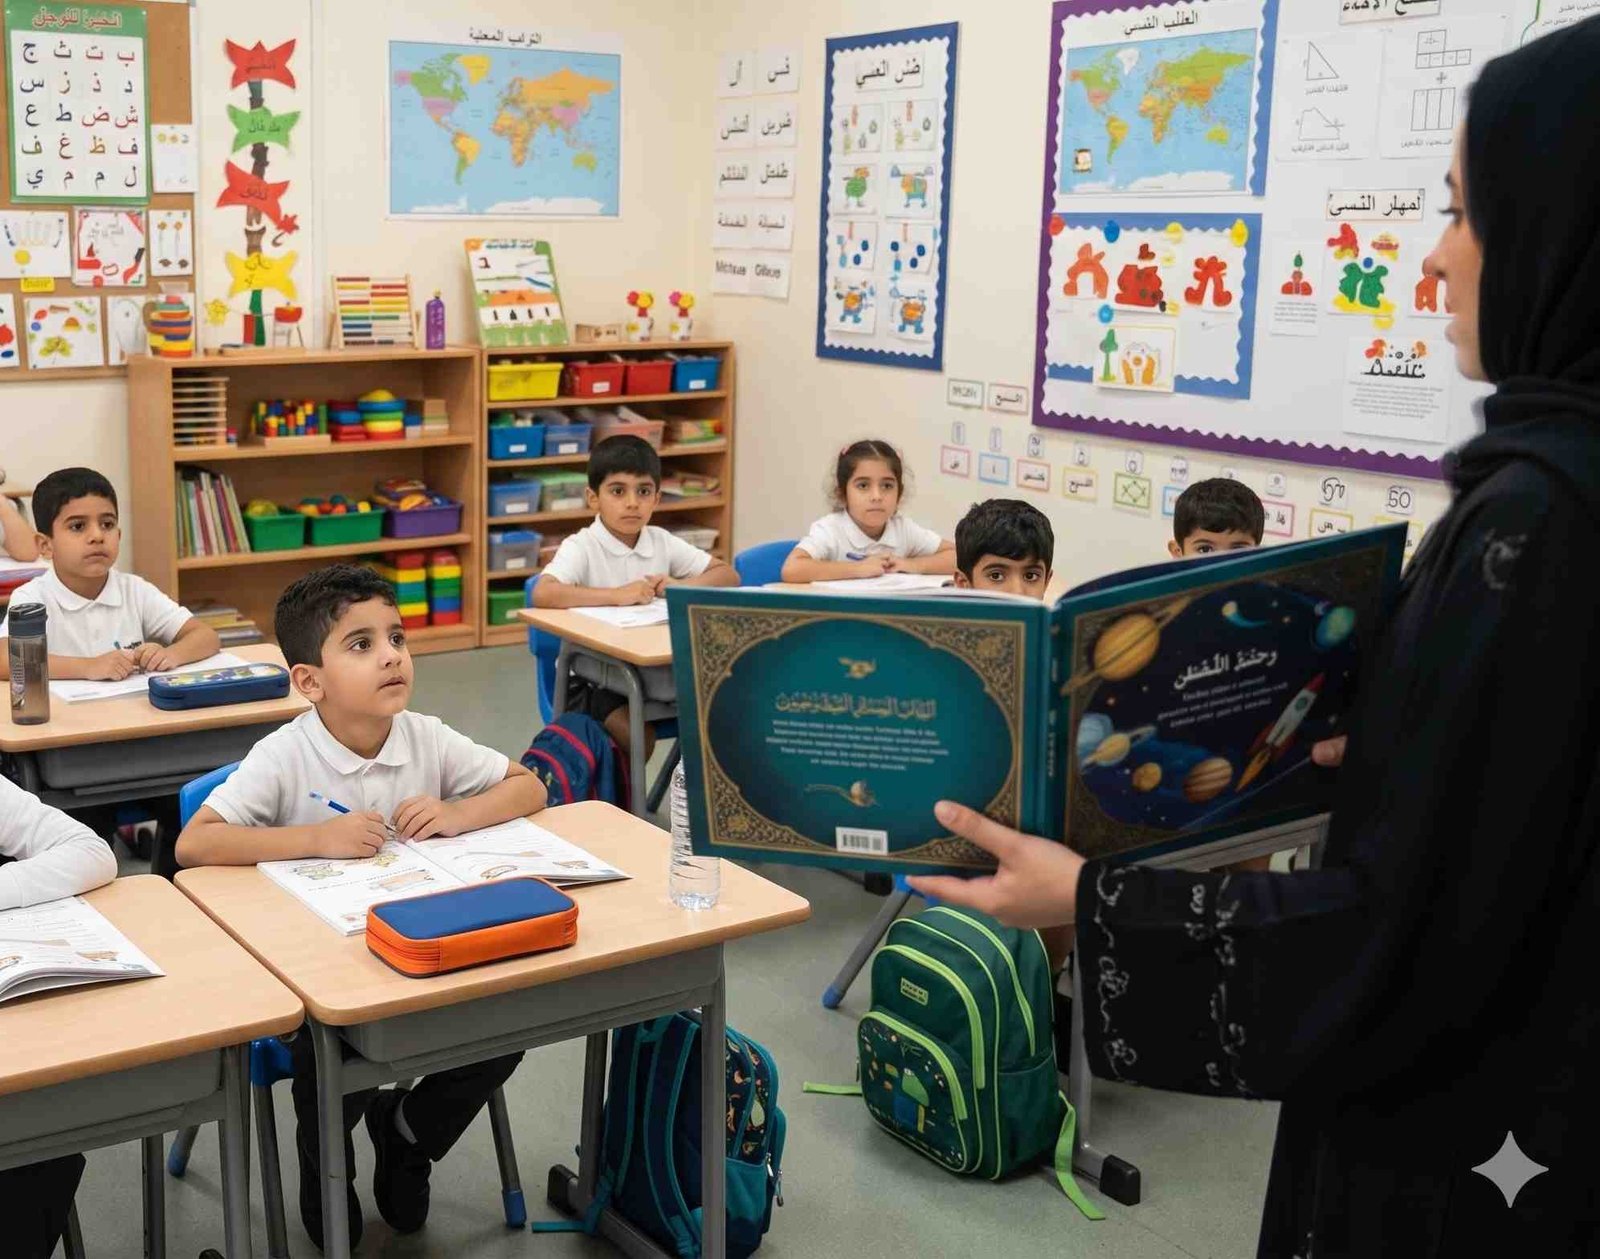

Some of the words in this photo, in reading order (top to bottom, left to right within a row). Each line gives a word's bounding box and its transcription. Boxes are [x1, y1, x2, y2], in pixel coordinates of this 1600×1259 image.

[23, 43, 39, 64] ج
[54, 41, 71, 58] ث
[86, 46, 103, 60] ت
[117, 51, 135, 67] ب
[20, 79, 44, 93] س
[60, 71, 71, 94] ز
[93, 72, 102, 92] ذ
[124, 80, 133, 93] د
[25, 104, 40, 127] ع
[56, 103, 72, 122] ط
[82, 106, 110, 127] ض
[115, 105, 139, 128] ش
[22, 135, 43, 155] ف
[59, 132, 74, 160] غ
[90, 136, 106, 154] ظ
[27, 169, 44, 189] ي
[64, 170, 74, 190] م
[95, 171, 105, 189] م
[125, 165, 137, 188] ل
